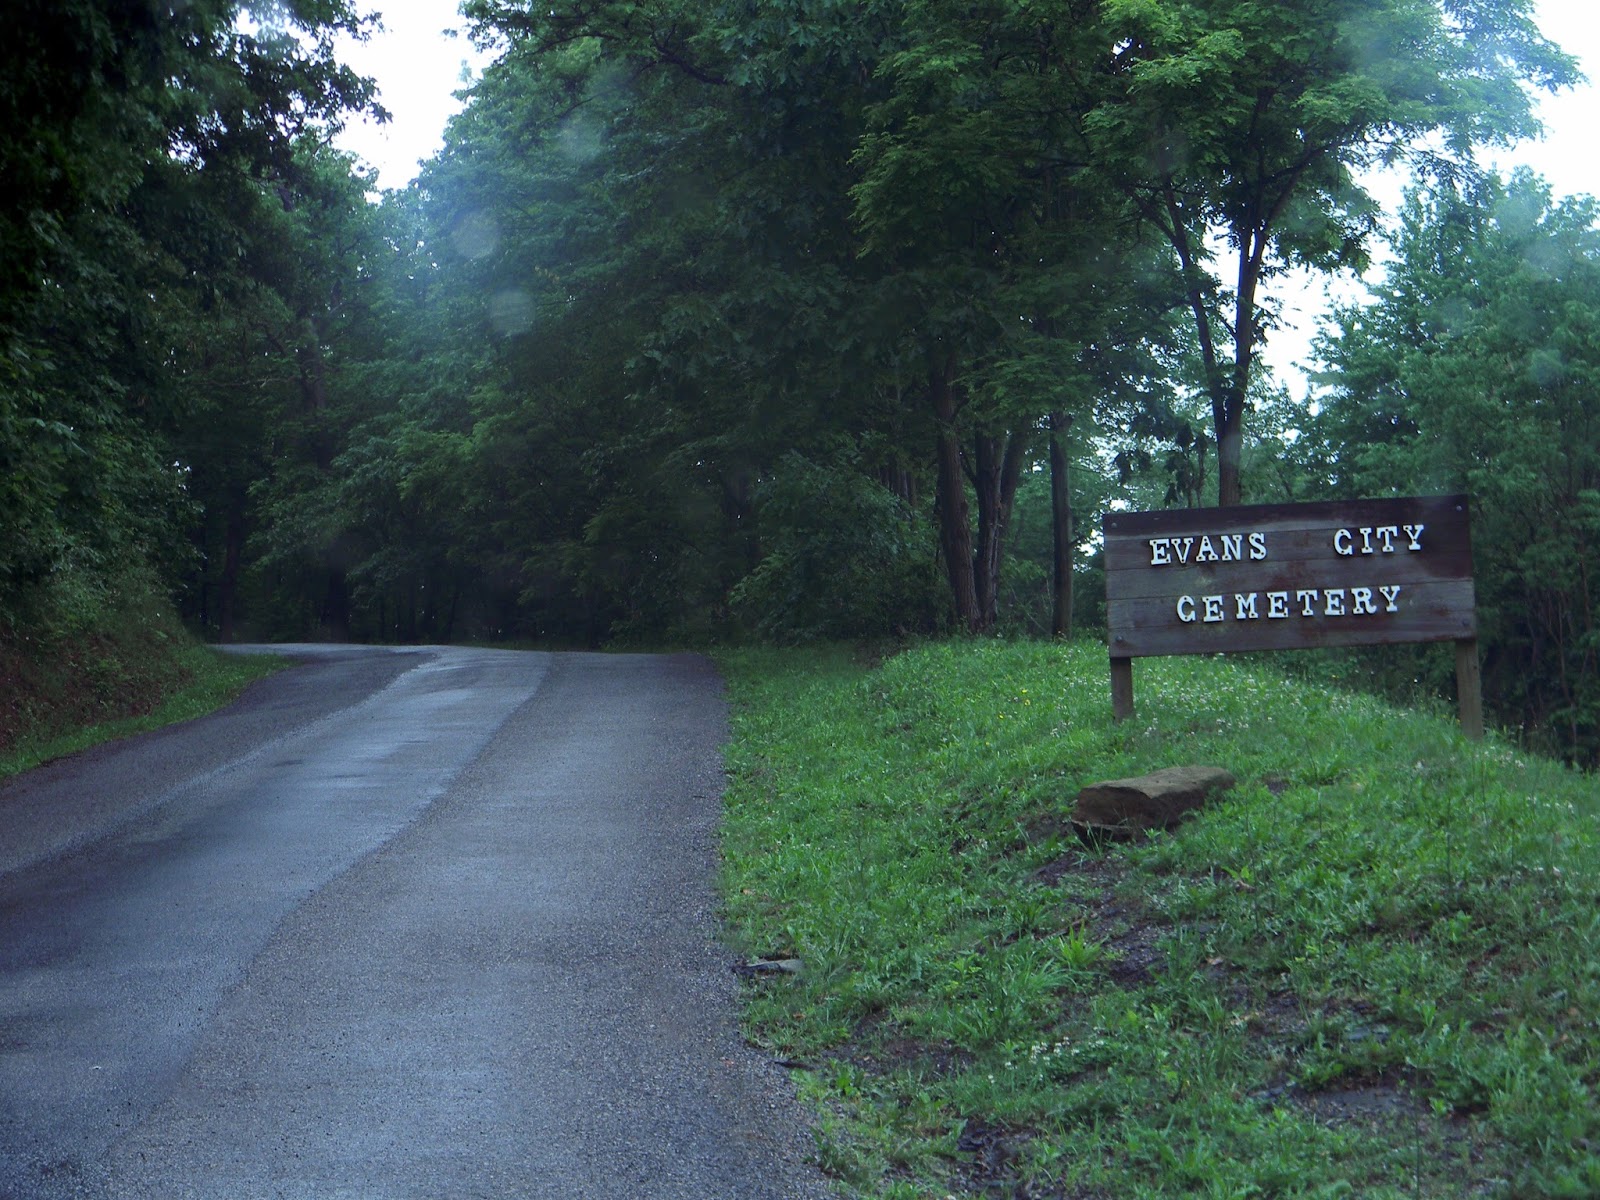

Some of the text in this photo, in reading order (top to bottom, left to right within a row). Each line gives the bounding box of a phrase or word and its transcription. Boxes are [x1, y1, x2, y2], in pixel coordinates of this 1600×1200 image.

[1149, 523, 1425, 566] EVANS CITY
[1176, 584, 1402, 623] CEMETERY
